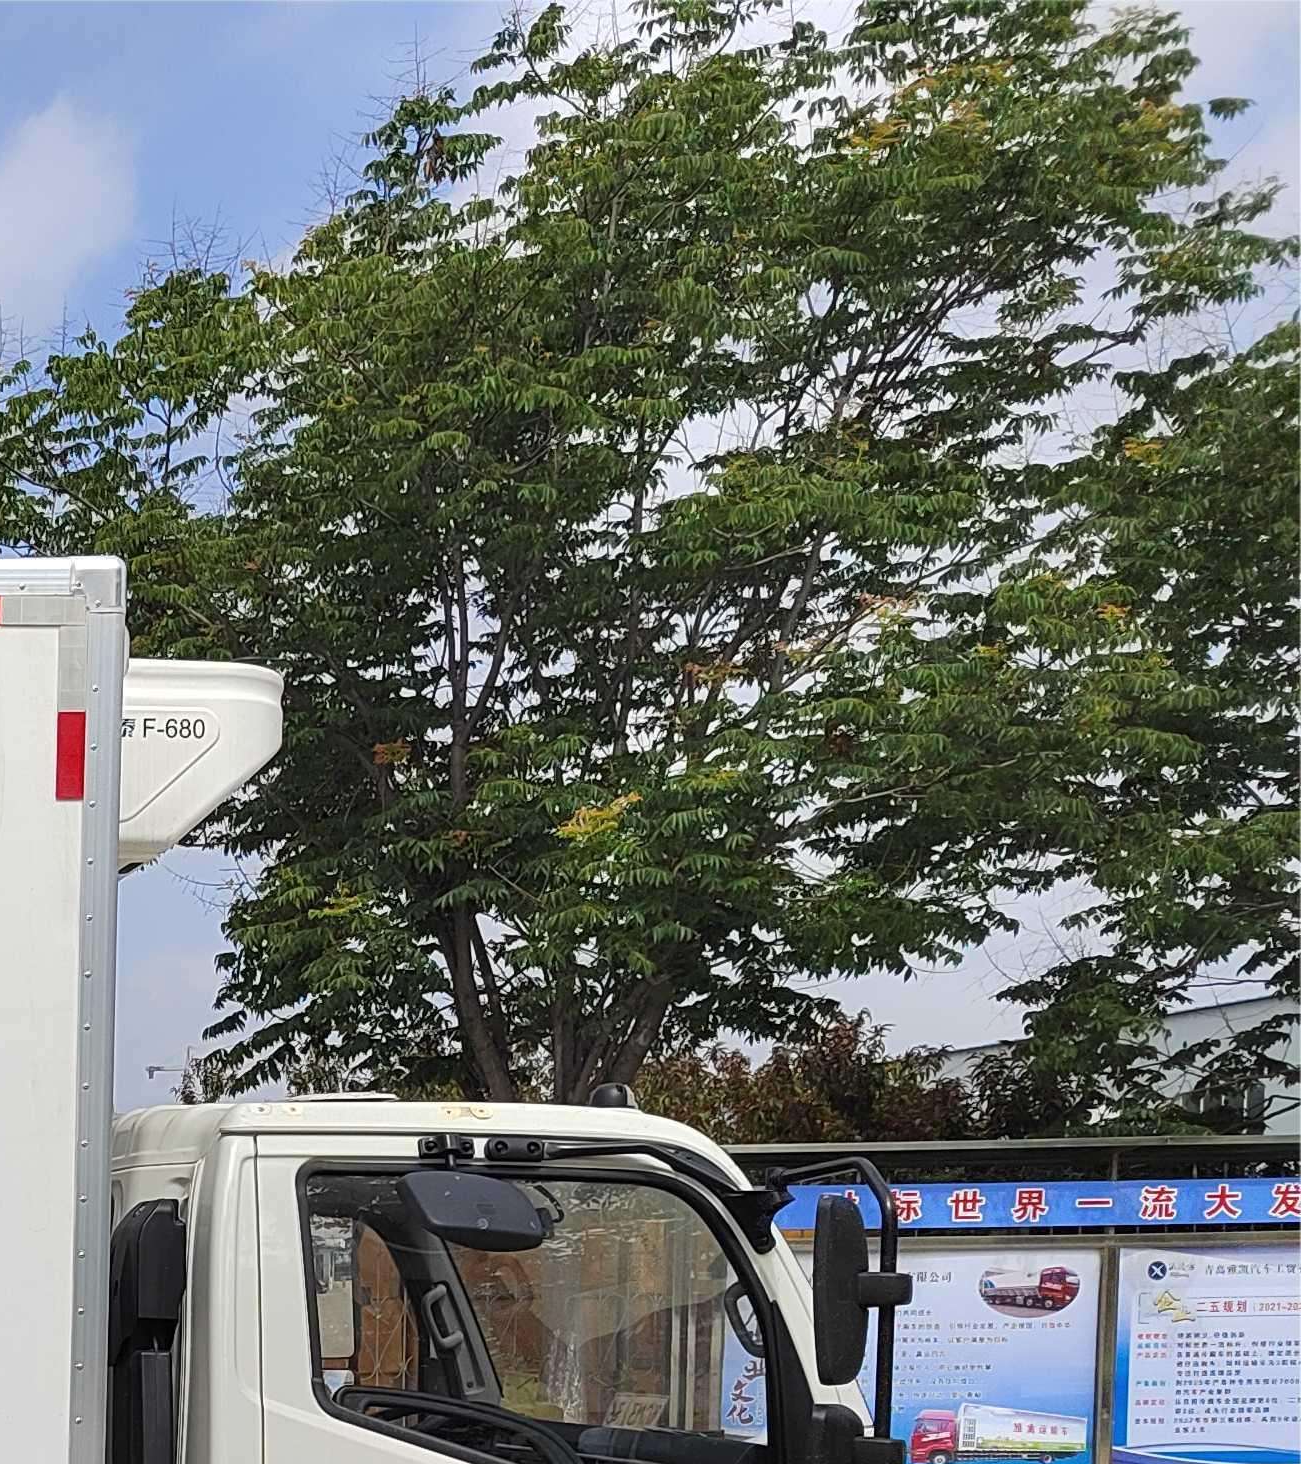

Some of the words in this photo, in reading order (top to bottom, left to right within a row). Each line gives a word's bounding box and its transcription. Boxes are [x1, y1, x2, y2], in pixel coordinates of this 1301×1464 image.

[143, 718, 205, 739] F-680
[821, 1184, 1301, 1222] 标世界一流大发
